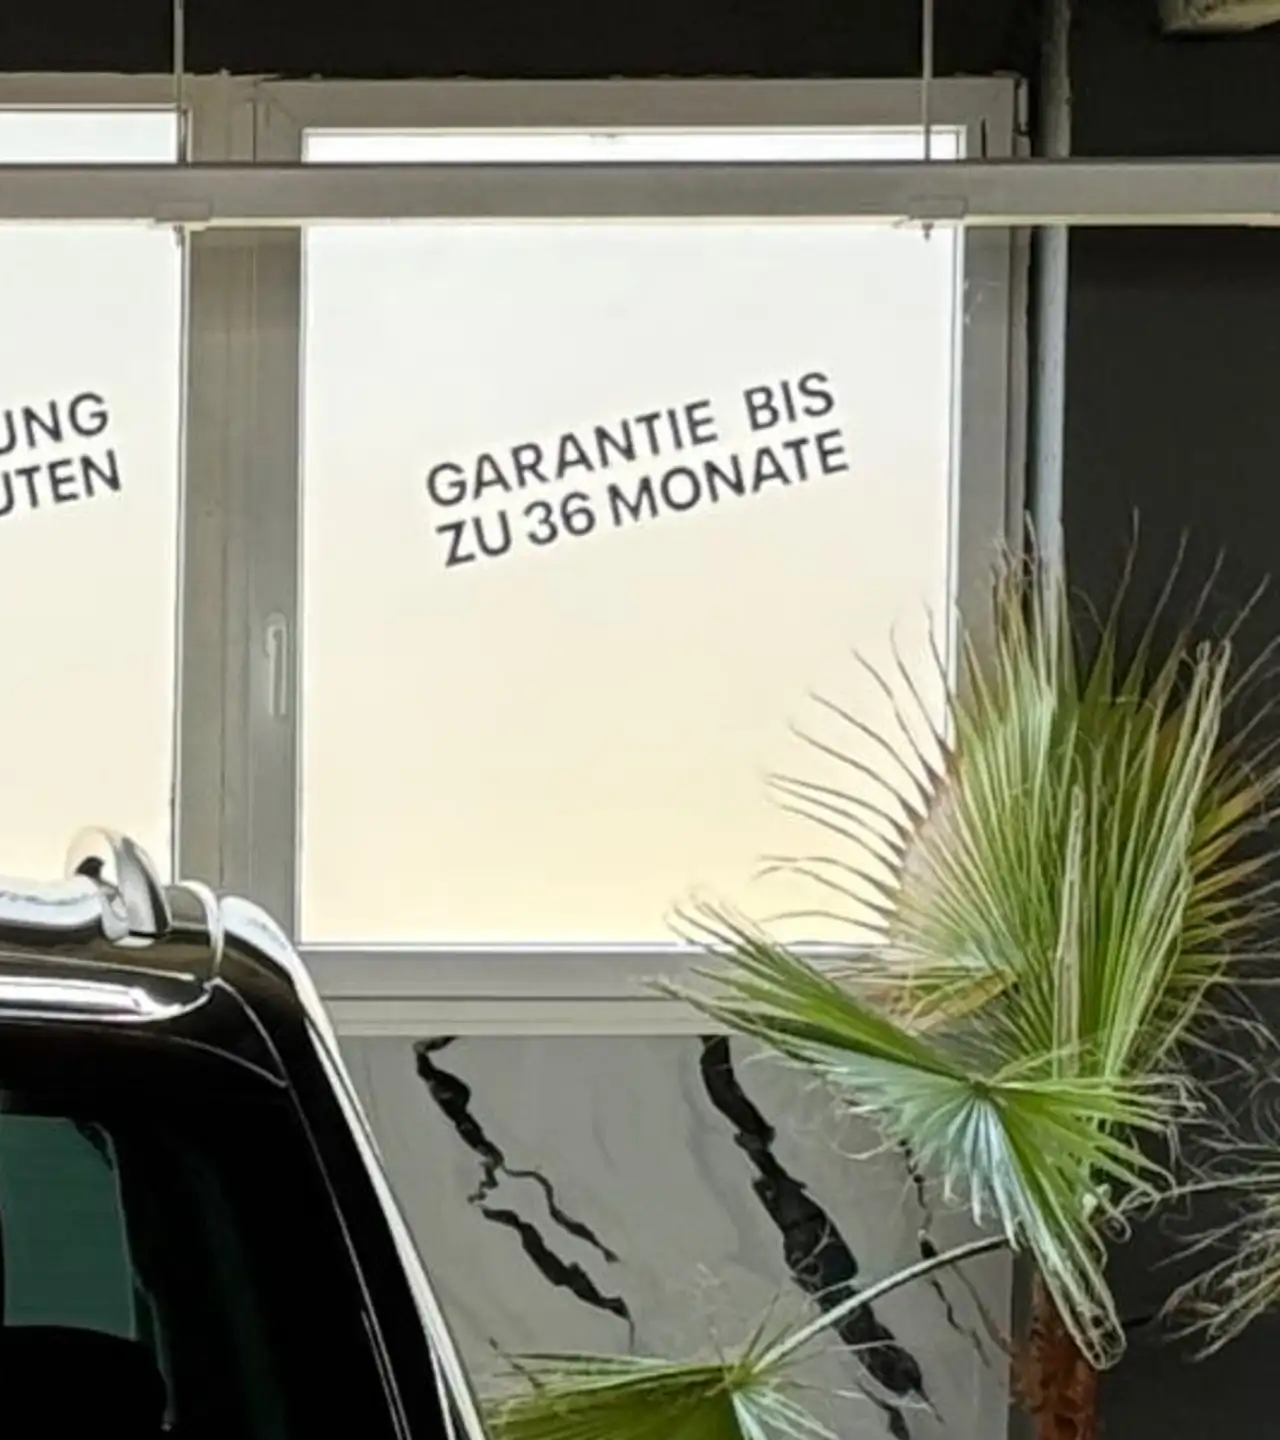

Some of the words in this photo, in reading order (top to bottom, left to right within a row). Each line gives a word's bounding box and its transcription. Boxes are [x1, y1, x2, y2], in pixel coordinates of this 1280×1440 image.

[426, 399, 719, 508] GARANTIE
[742, 371, 835, 432] BIS
[435, 509, 513, 567] ZU
[524, 491, 596, 546] 36
[606, 428, 850, 527] MONATE
